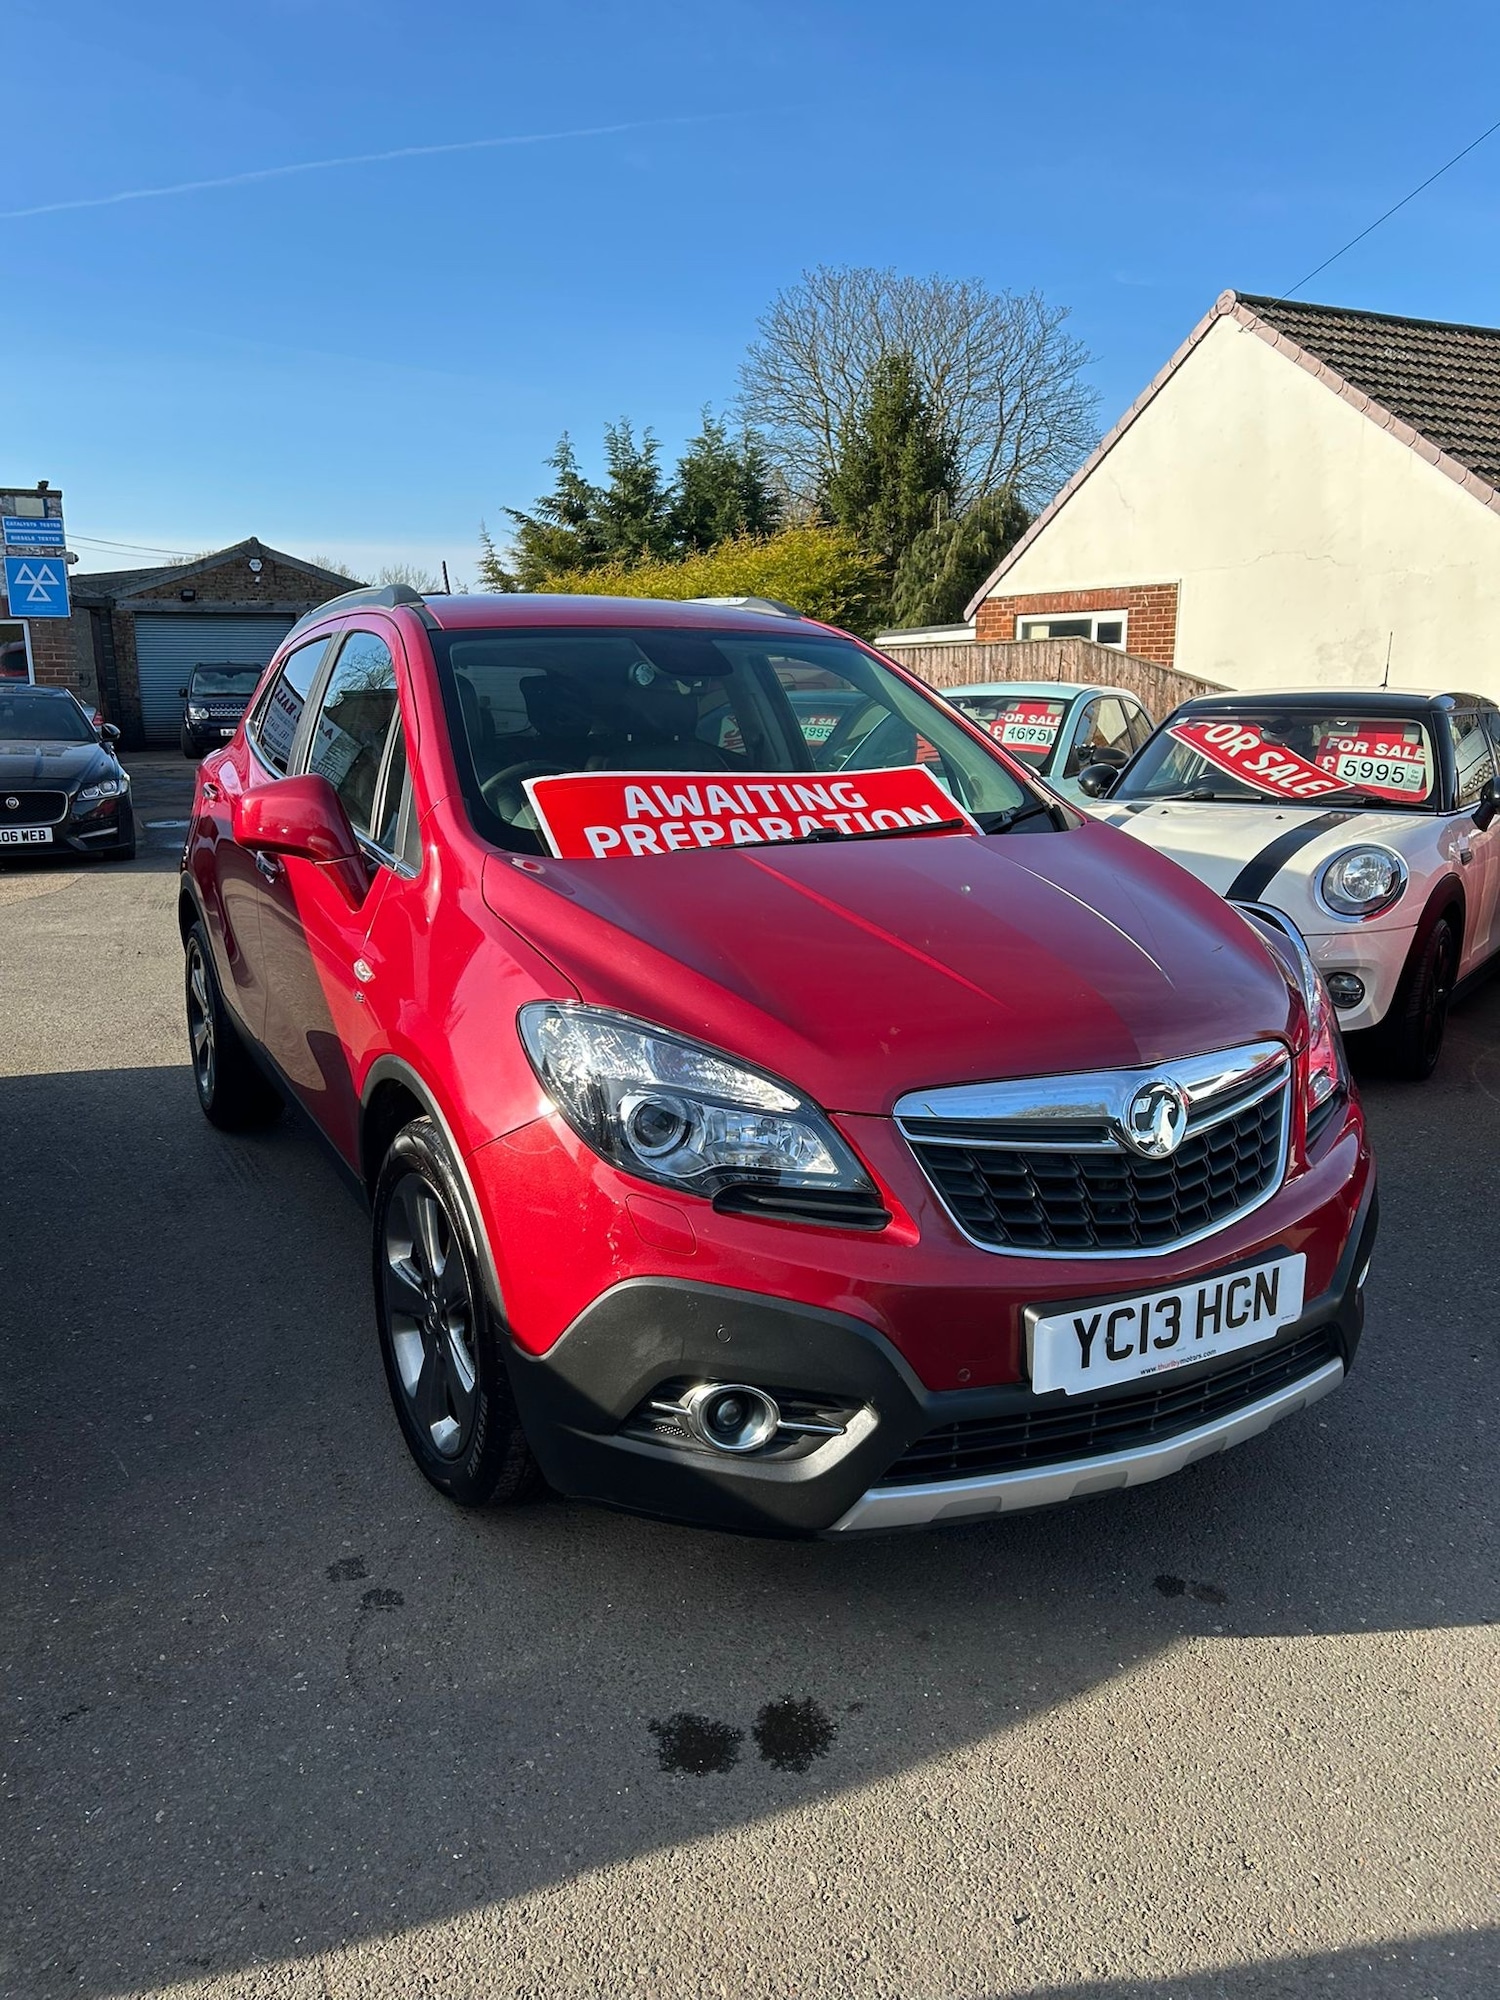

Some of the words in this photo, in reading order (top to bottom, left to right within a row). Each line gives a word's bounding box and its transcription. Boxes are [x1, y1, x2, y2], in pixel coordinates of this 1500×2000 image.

[800, 717, 817, 725] OR
[818, 717, 838, 726] SAL
[993, 725, 1003, 739] £
[1008, 727, 1047, 741] 4695
[1027, 713, 1063, 727] SALE
[1326, 737, 1369, 754] FOR
[1374, 743, 1425, 762] SALE
[1241, 751, 1336, 795] SALE
[1321, 756, 1336, 771] £
[1343, 760, 1406, 784] 5995
[624, 782, 869, 819] AWAITING
[0, 831, 18, 843] 06
[21, 830, 46, 842] WEB
[583, 804, 942, 859] PREPARATION
[1073, 1296, 1182, 1369] YC13
[1195, 1267, 1280, 1340] HCN
